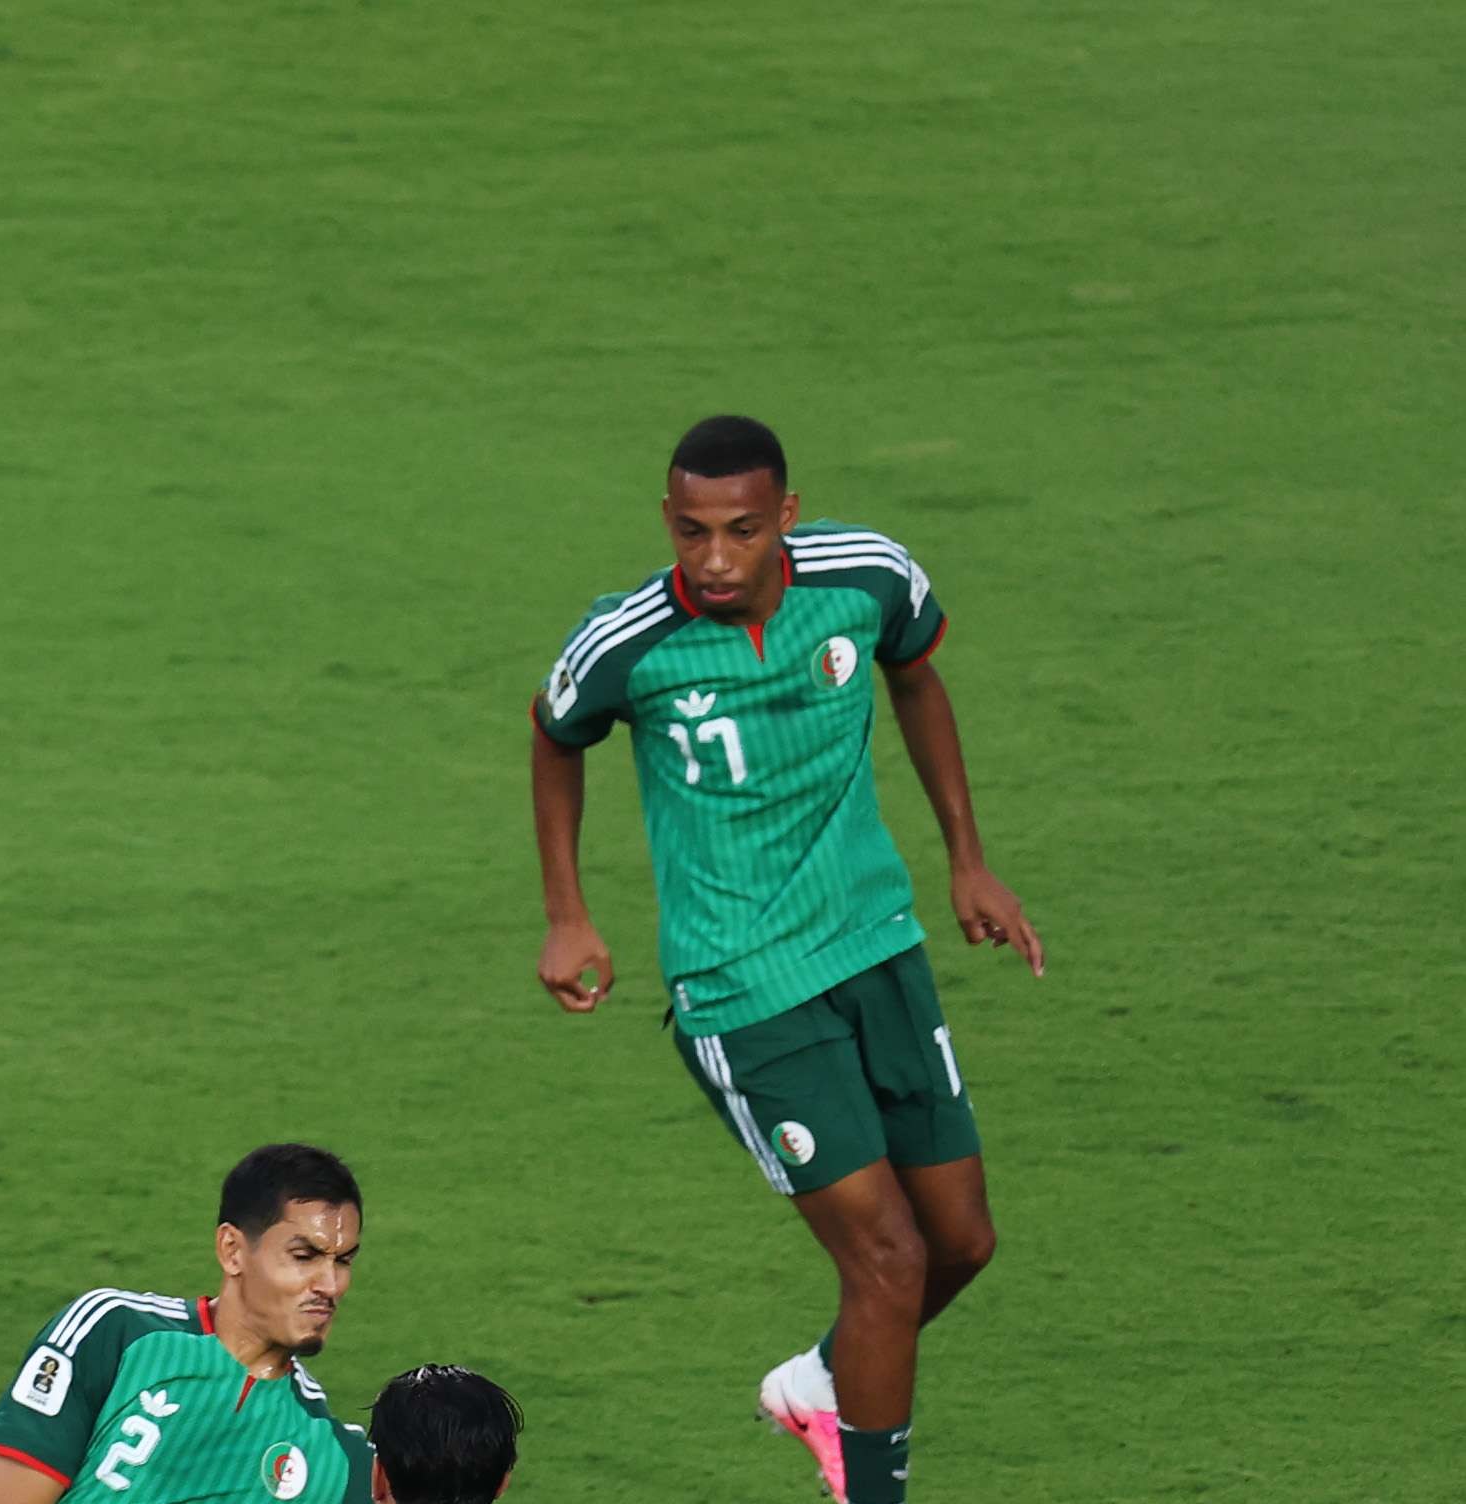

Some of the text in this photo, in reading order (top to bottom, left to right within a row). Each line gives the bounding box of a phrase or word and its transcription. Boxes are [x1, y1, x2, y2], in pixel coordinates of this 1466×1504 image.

[668, 716, 748, 785] 17
[933, 1023, 962, 1098] 1
[95, 1414, 162, 1492] 2
